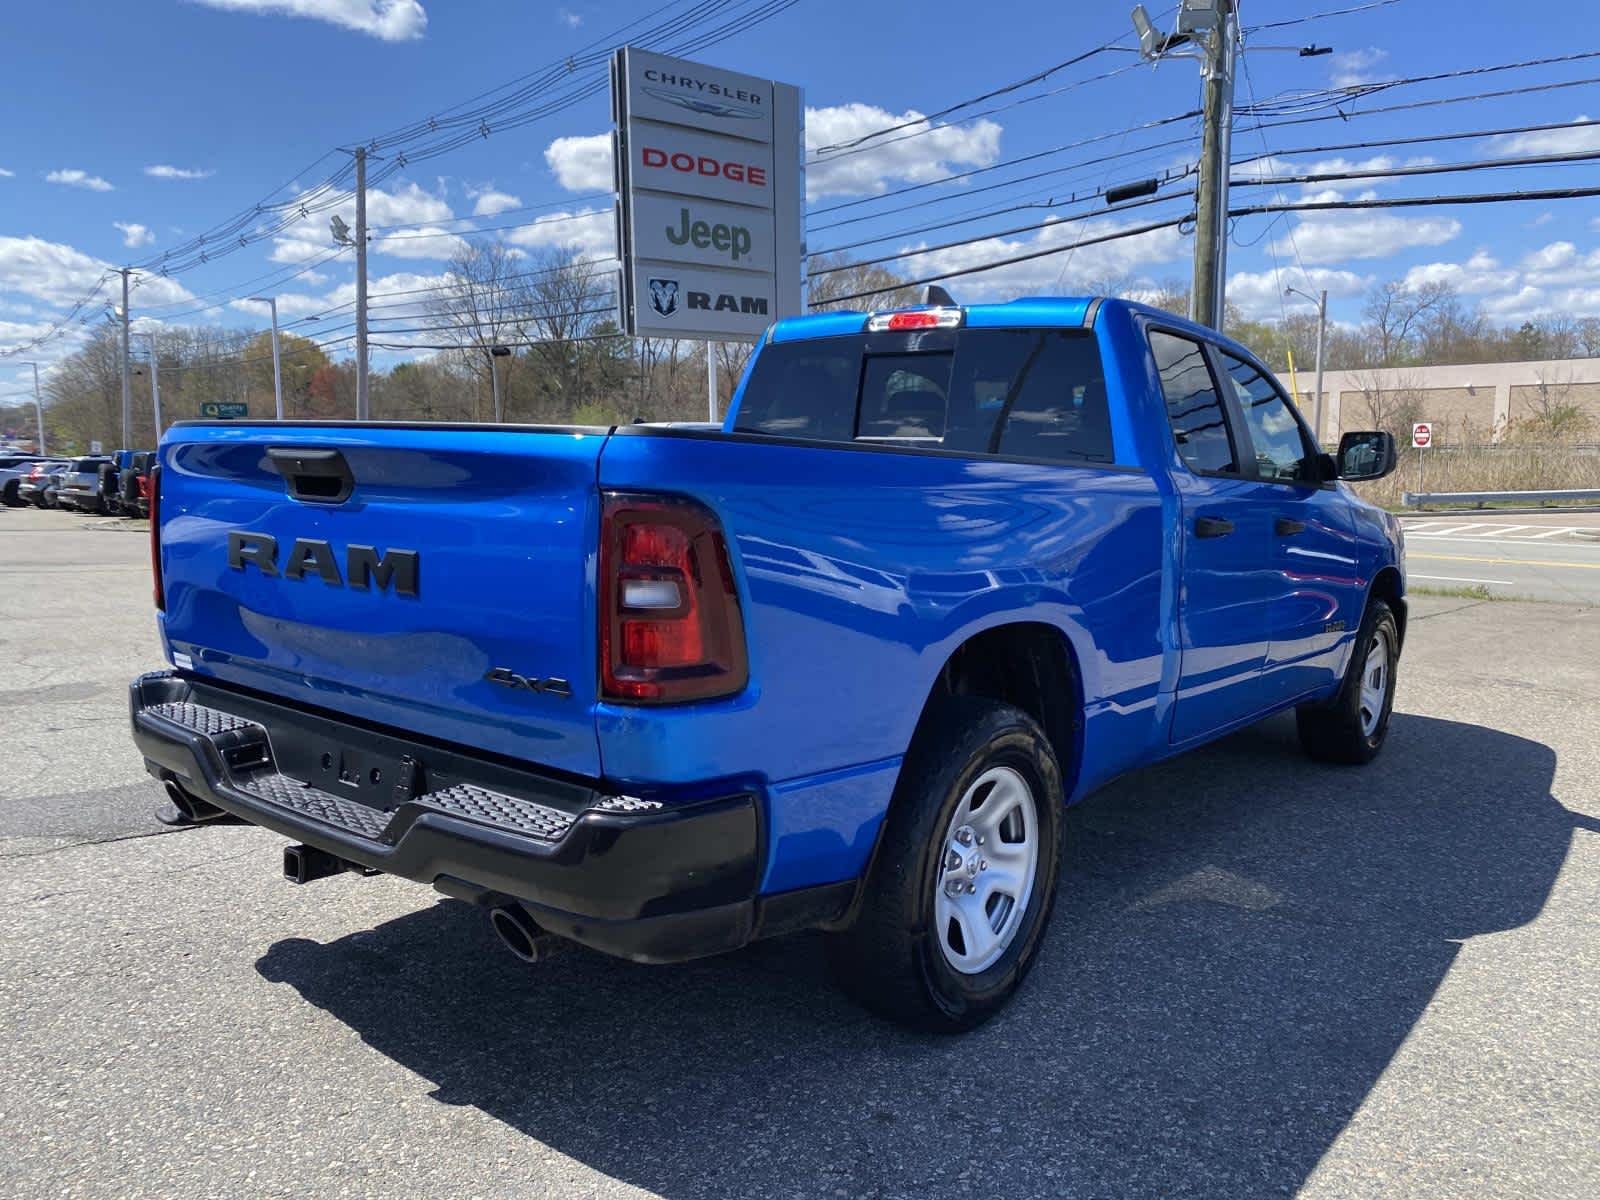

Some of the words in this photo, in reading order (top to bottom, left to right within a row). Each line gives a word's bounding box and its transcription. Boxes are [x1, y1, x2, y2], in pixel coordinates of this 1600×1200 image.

[644, 69, 762, 105] CHRYSLER
[642, 147, 767, 187] DODGE
[665, 207, 752, 261] Jeep
[686, 291, 769, 316] RAM
[227, 530, 420, 597] RAM
